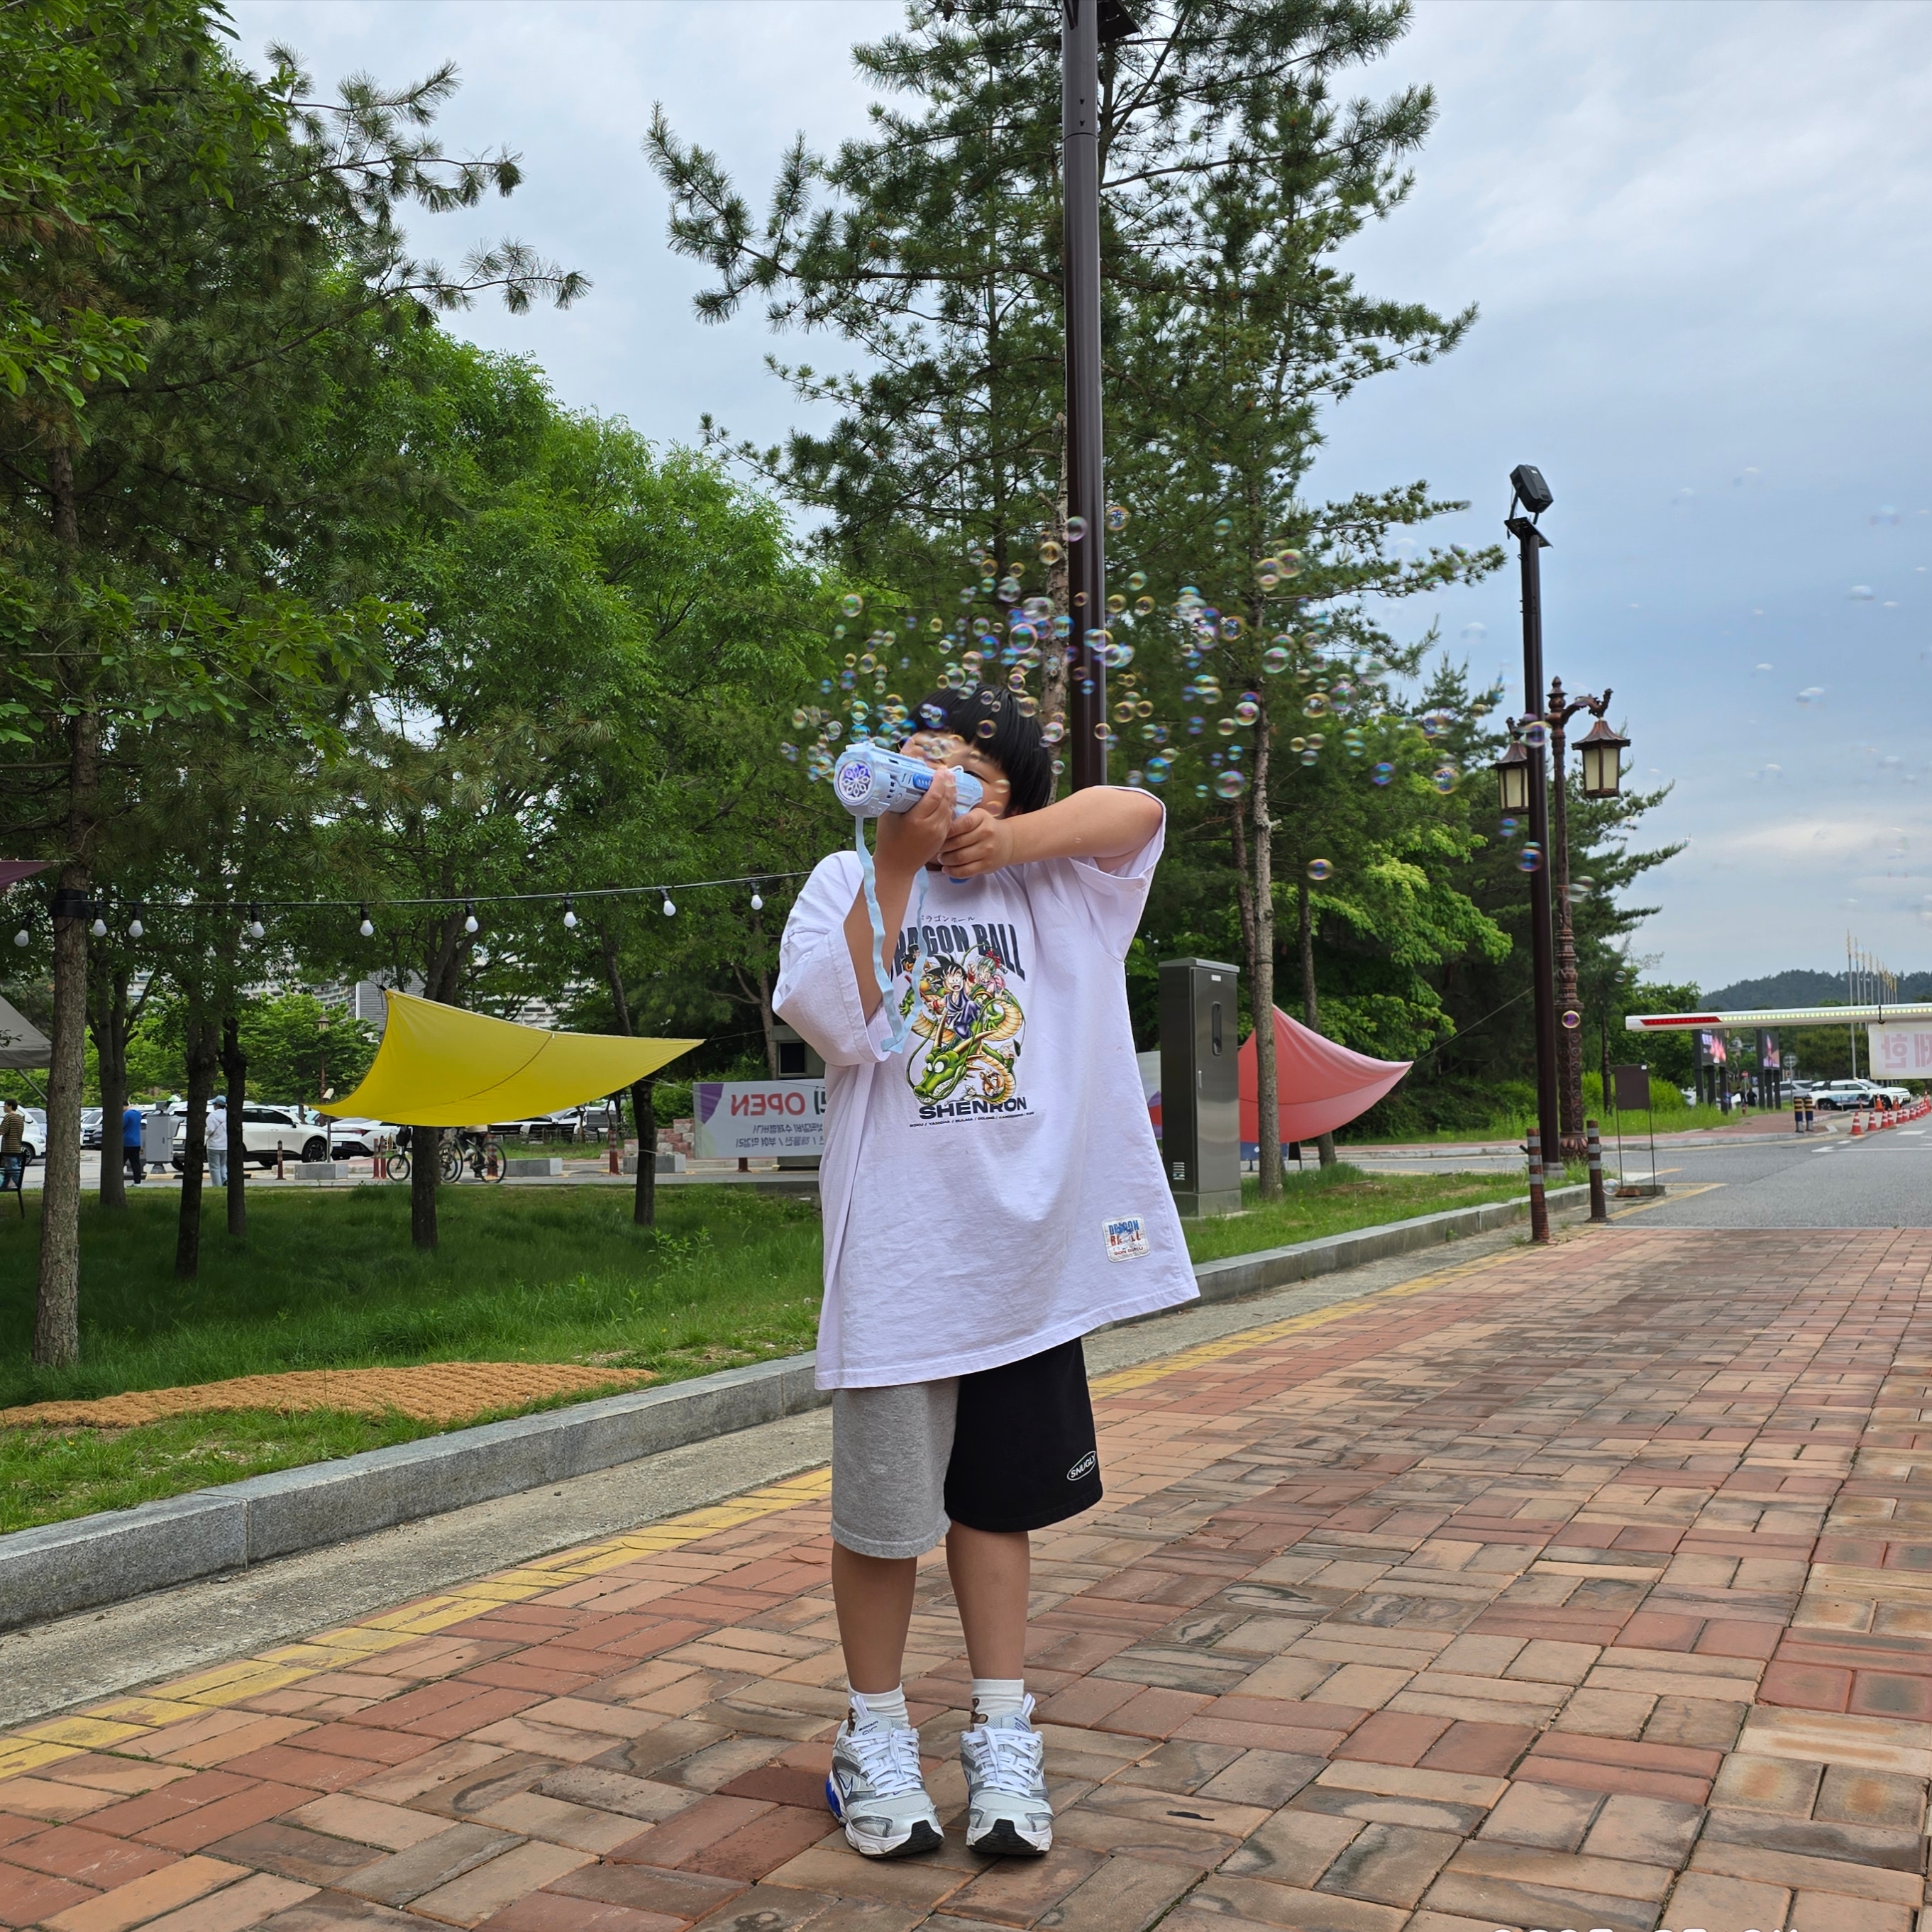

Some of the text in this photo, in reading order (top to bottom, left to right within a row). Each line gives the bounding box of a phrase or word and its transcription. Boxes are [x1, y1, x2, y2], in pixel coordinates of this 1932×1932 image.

[921, 915, 976, 923] ラゴンボール
[890, 923, 1026, 982] RAGON BALL
[919, 1096, 1027, 1120] SHENRON
